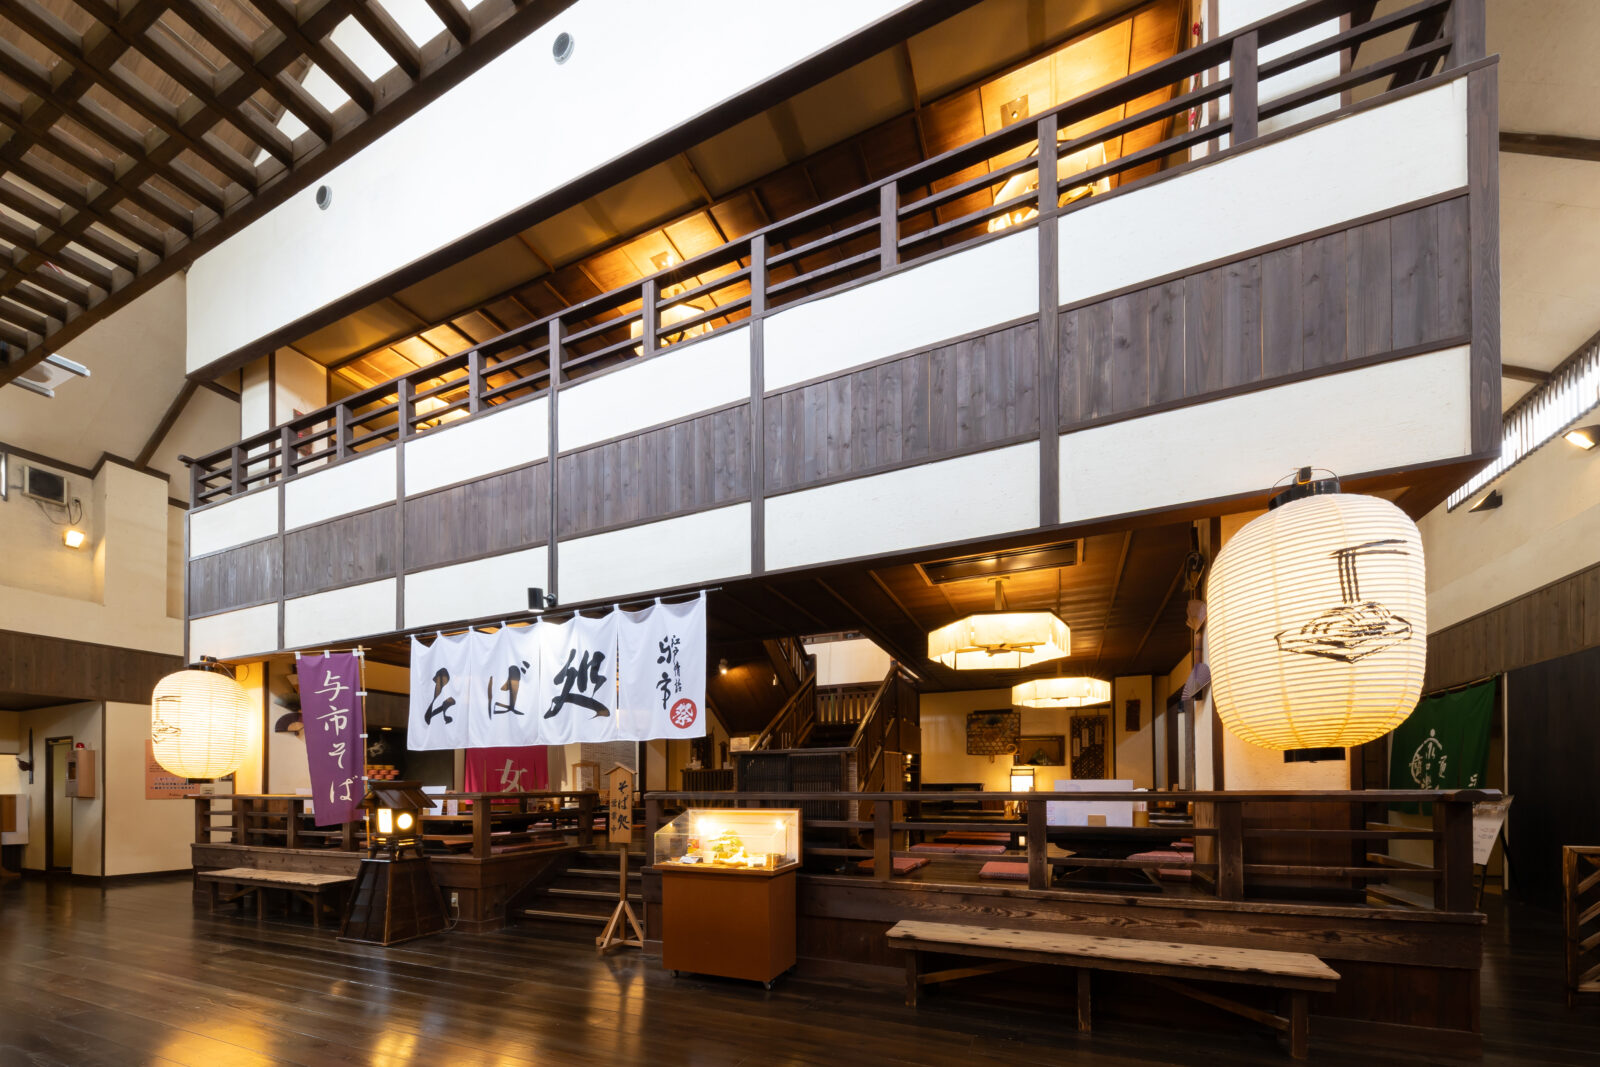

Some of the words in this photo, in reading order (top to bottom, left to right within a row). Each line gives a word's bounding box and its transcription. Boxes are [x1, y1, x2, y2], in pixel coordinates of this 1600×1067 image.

[671, 701, 695, 727] 祭
[313, 669, 358, 804] 与市そば
[495, 758, 529, 793] 女
